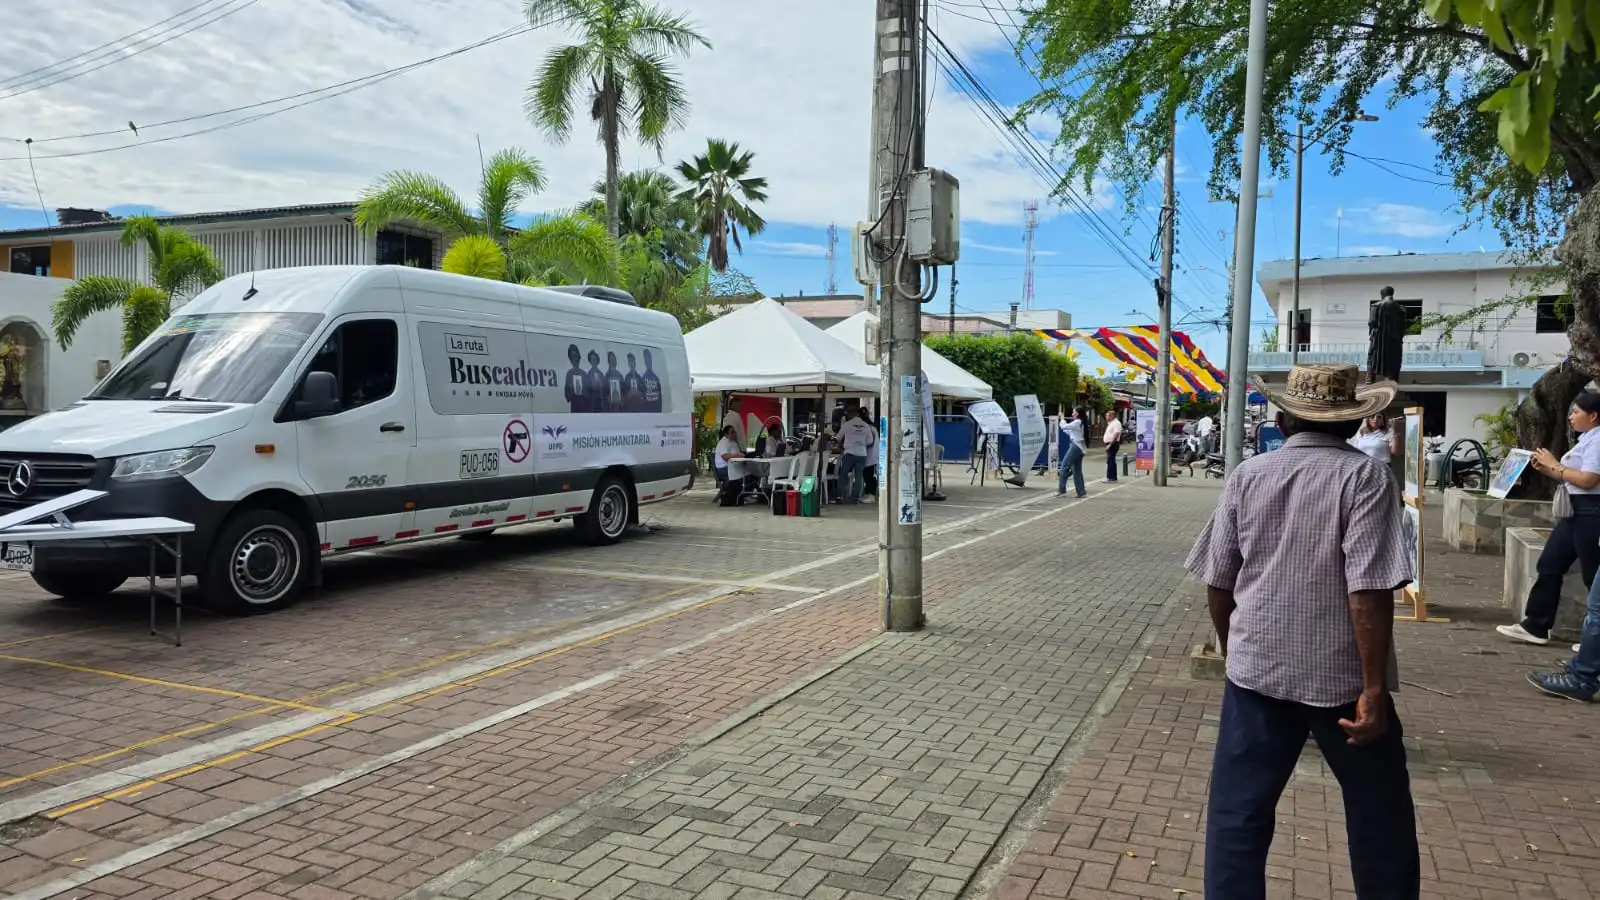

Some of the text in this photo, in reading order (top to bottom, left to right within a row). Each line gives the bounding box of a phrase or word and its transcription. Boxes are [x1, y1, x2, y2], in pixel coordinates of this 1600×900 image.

[450, 336, 484, 351] La ruta
[1407, 352, 1463, 364] ERRALTA
[448, 356, 558, 387] Buscadora
[572, 433, 600, 449] MISIÓN
[601, 434, 651, 448] HUMANITARIA
[461, 451, 498, 473] PUO-056
[345, 473, 388, 489] 2056
